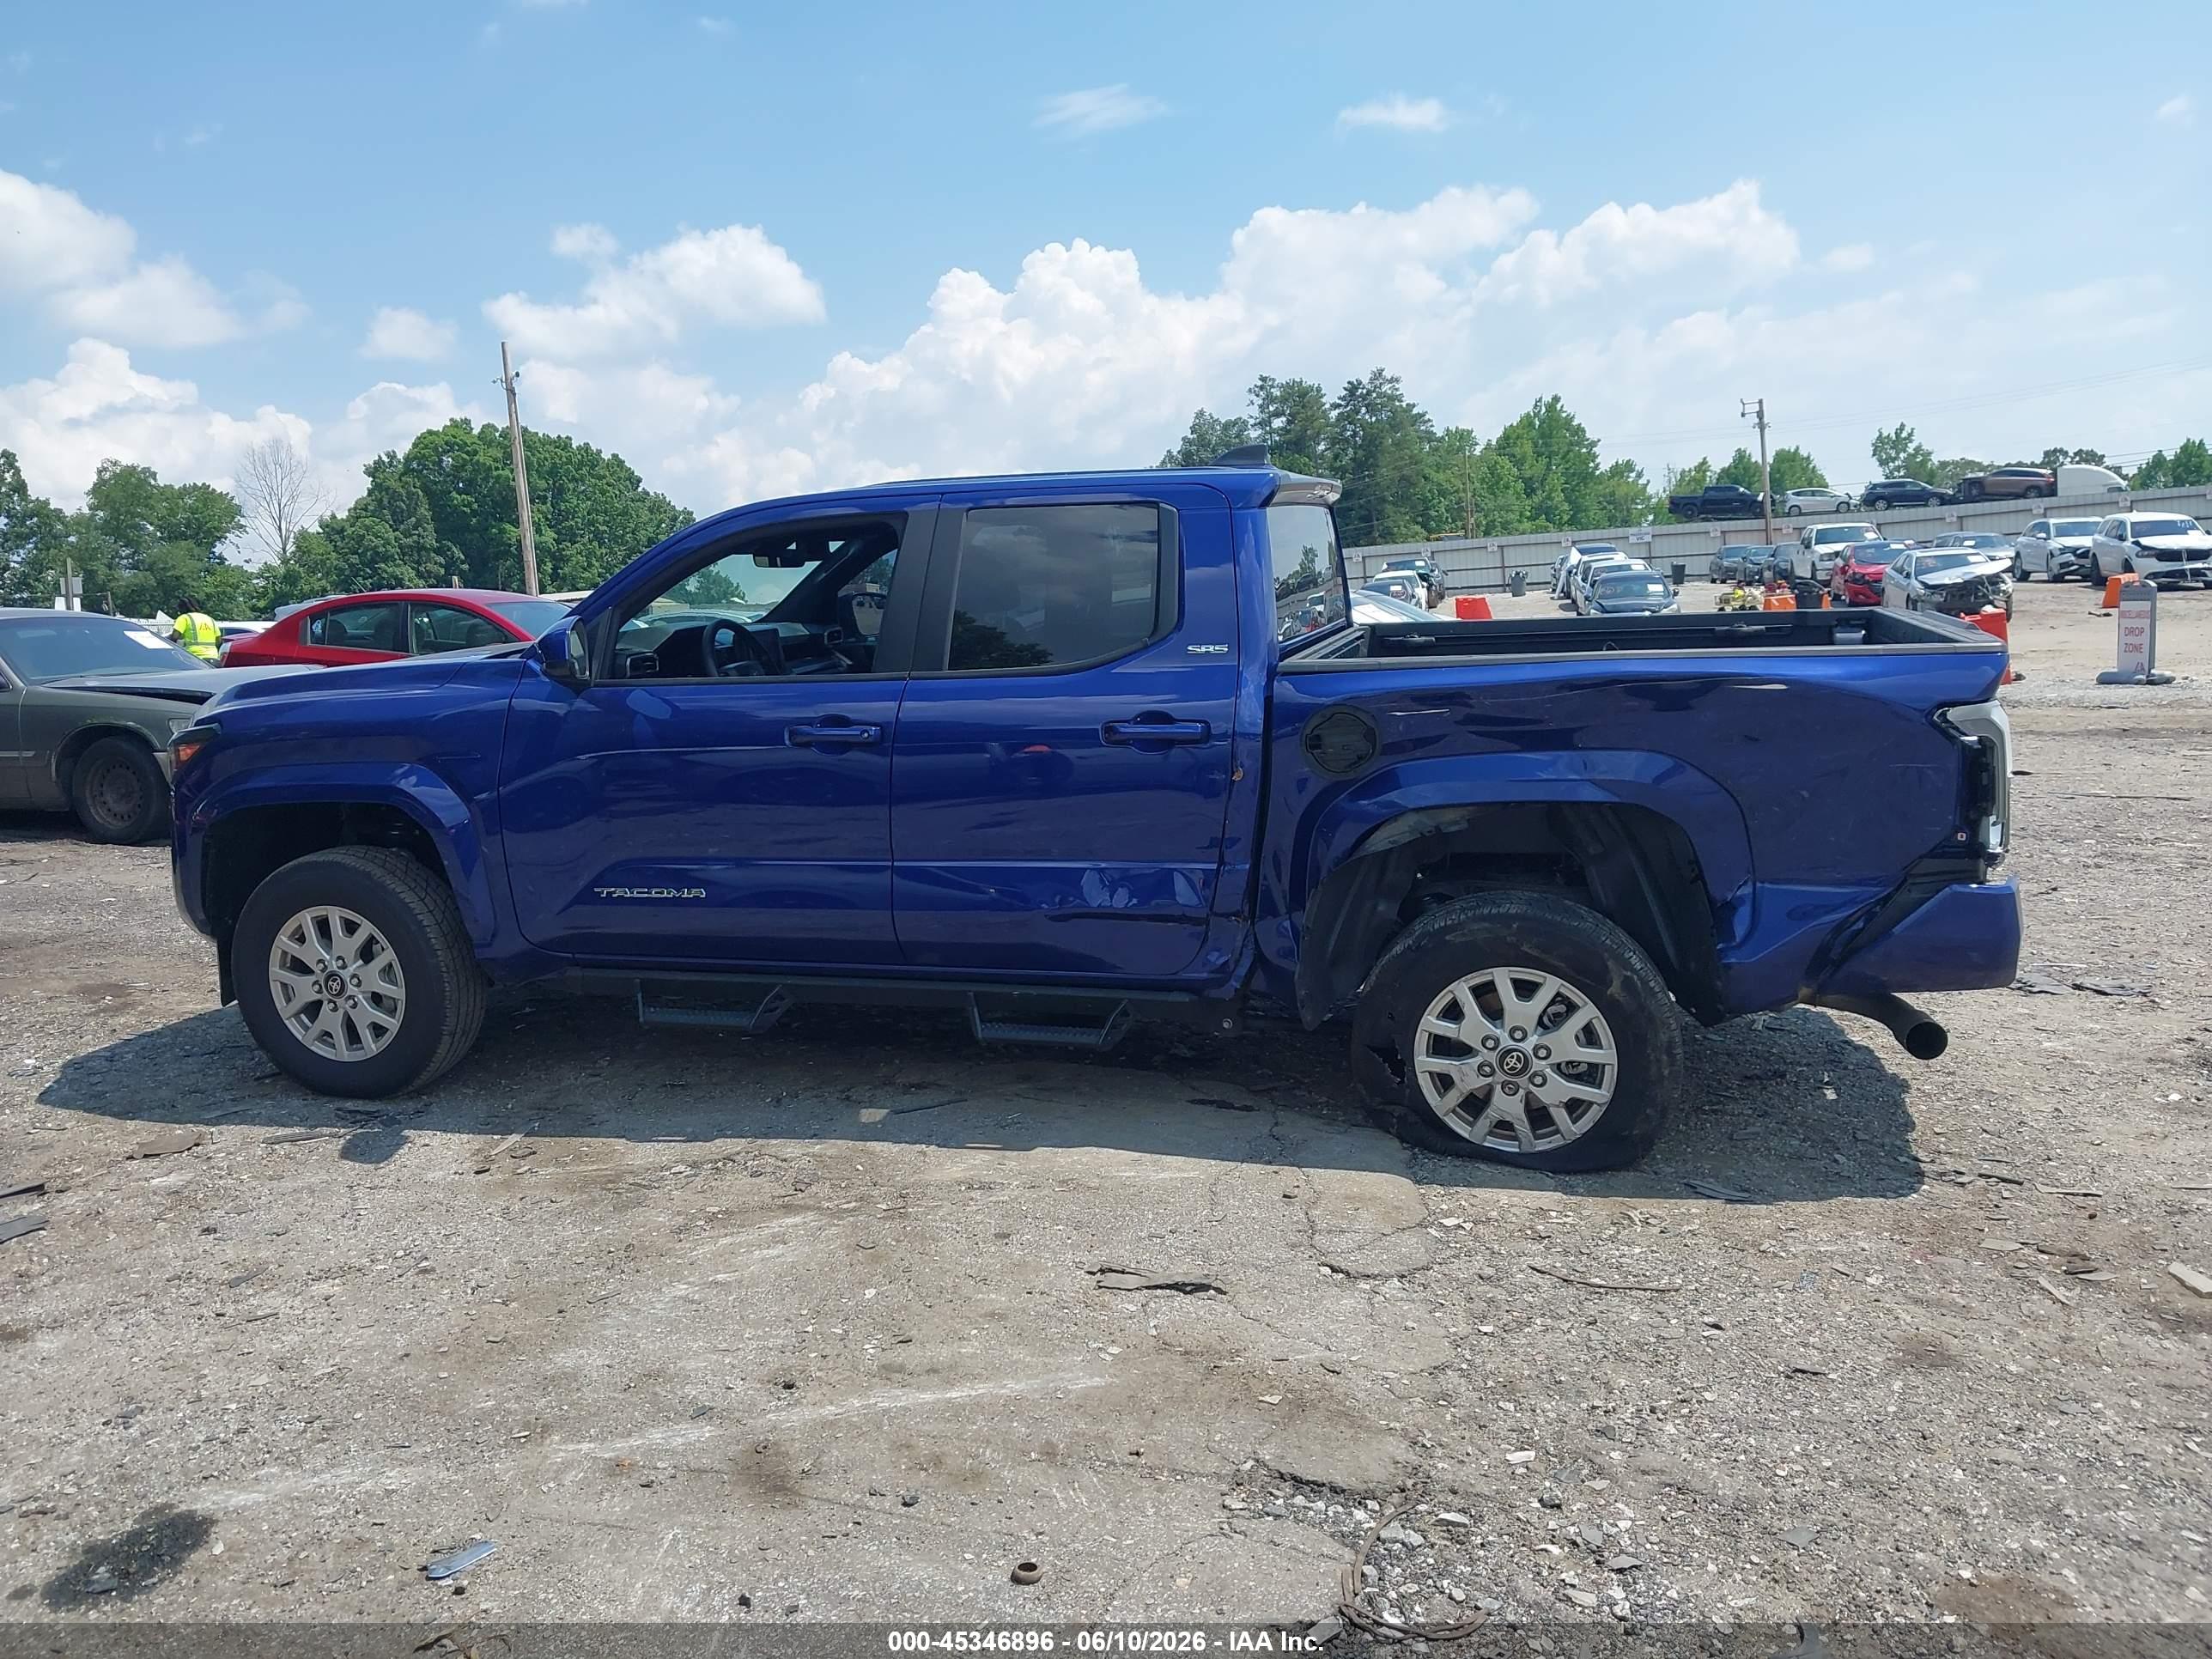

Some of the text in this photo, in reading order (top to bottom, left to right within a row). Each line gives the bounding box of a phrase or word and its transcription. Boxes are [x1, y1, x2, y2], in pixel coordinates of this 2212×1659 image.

[2124, 626, 2145, 637] DROP
[1187, 644, 1229, 653] SR5
[2124, 643, 2144, 653] ZONE
[593, 887, 707, 898] TACOMA
